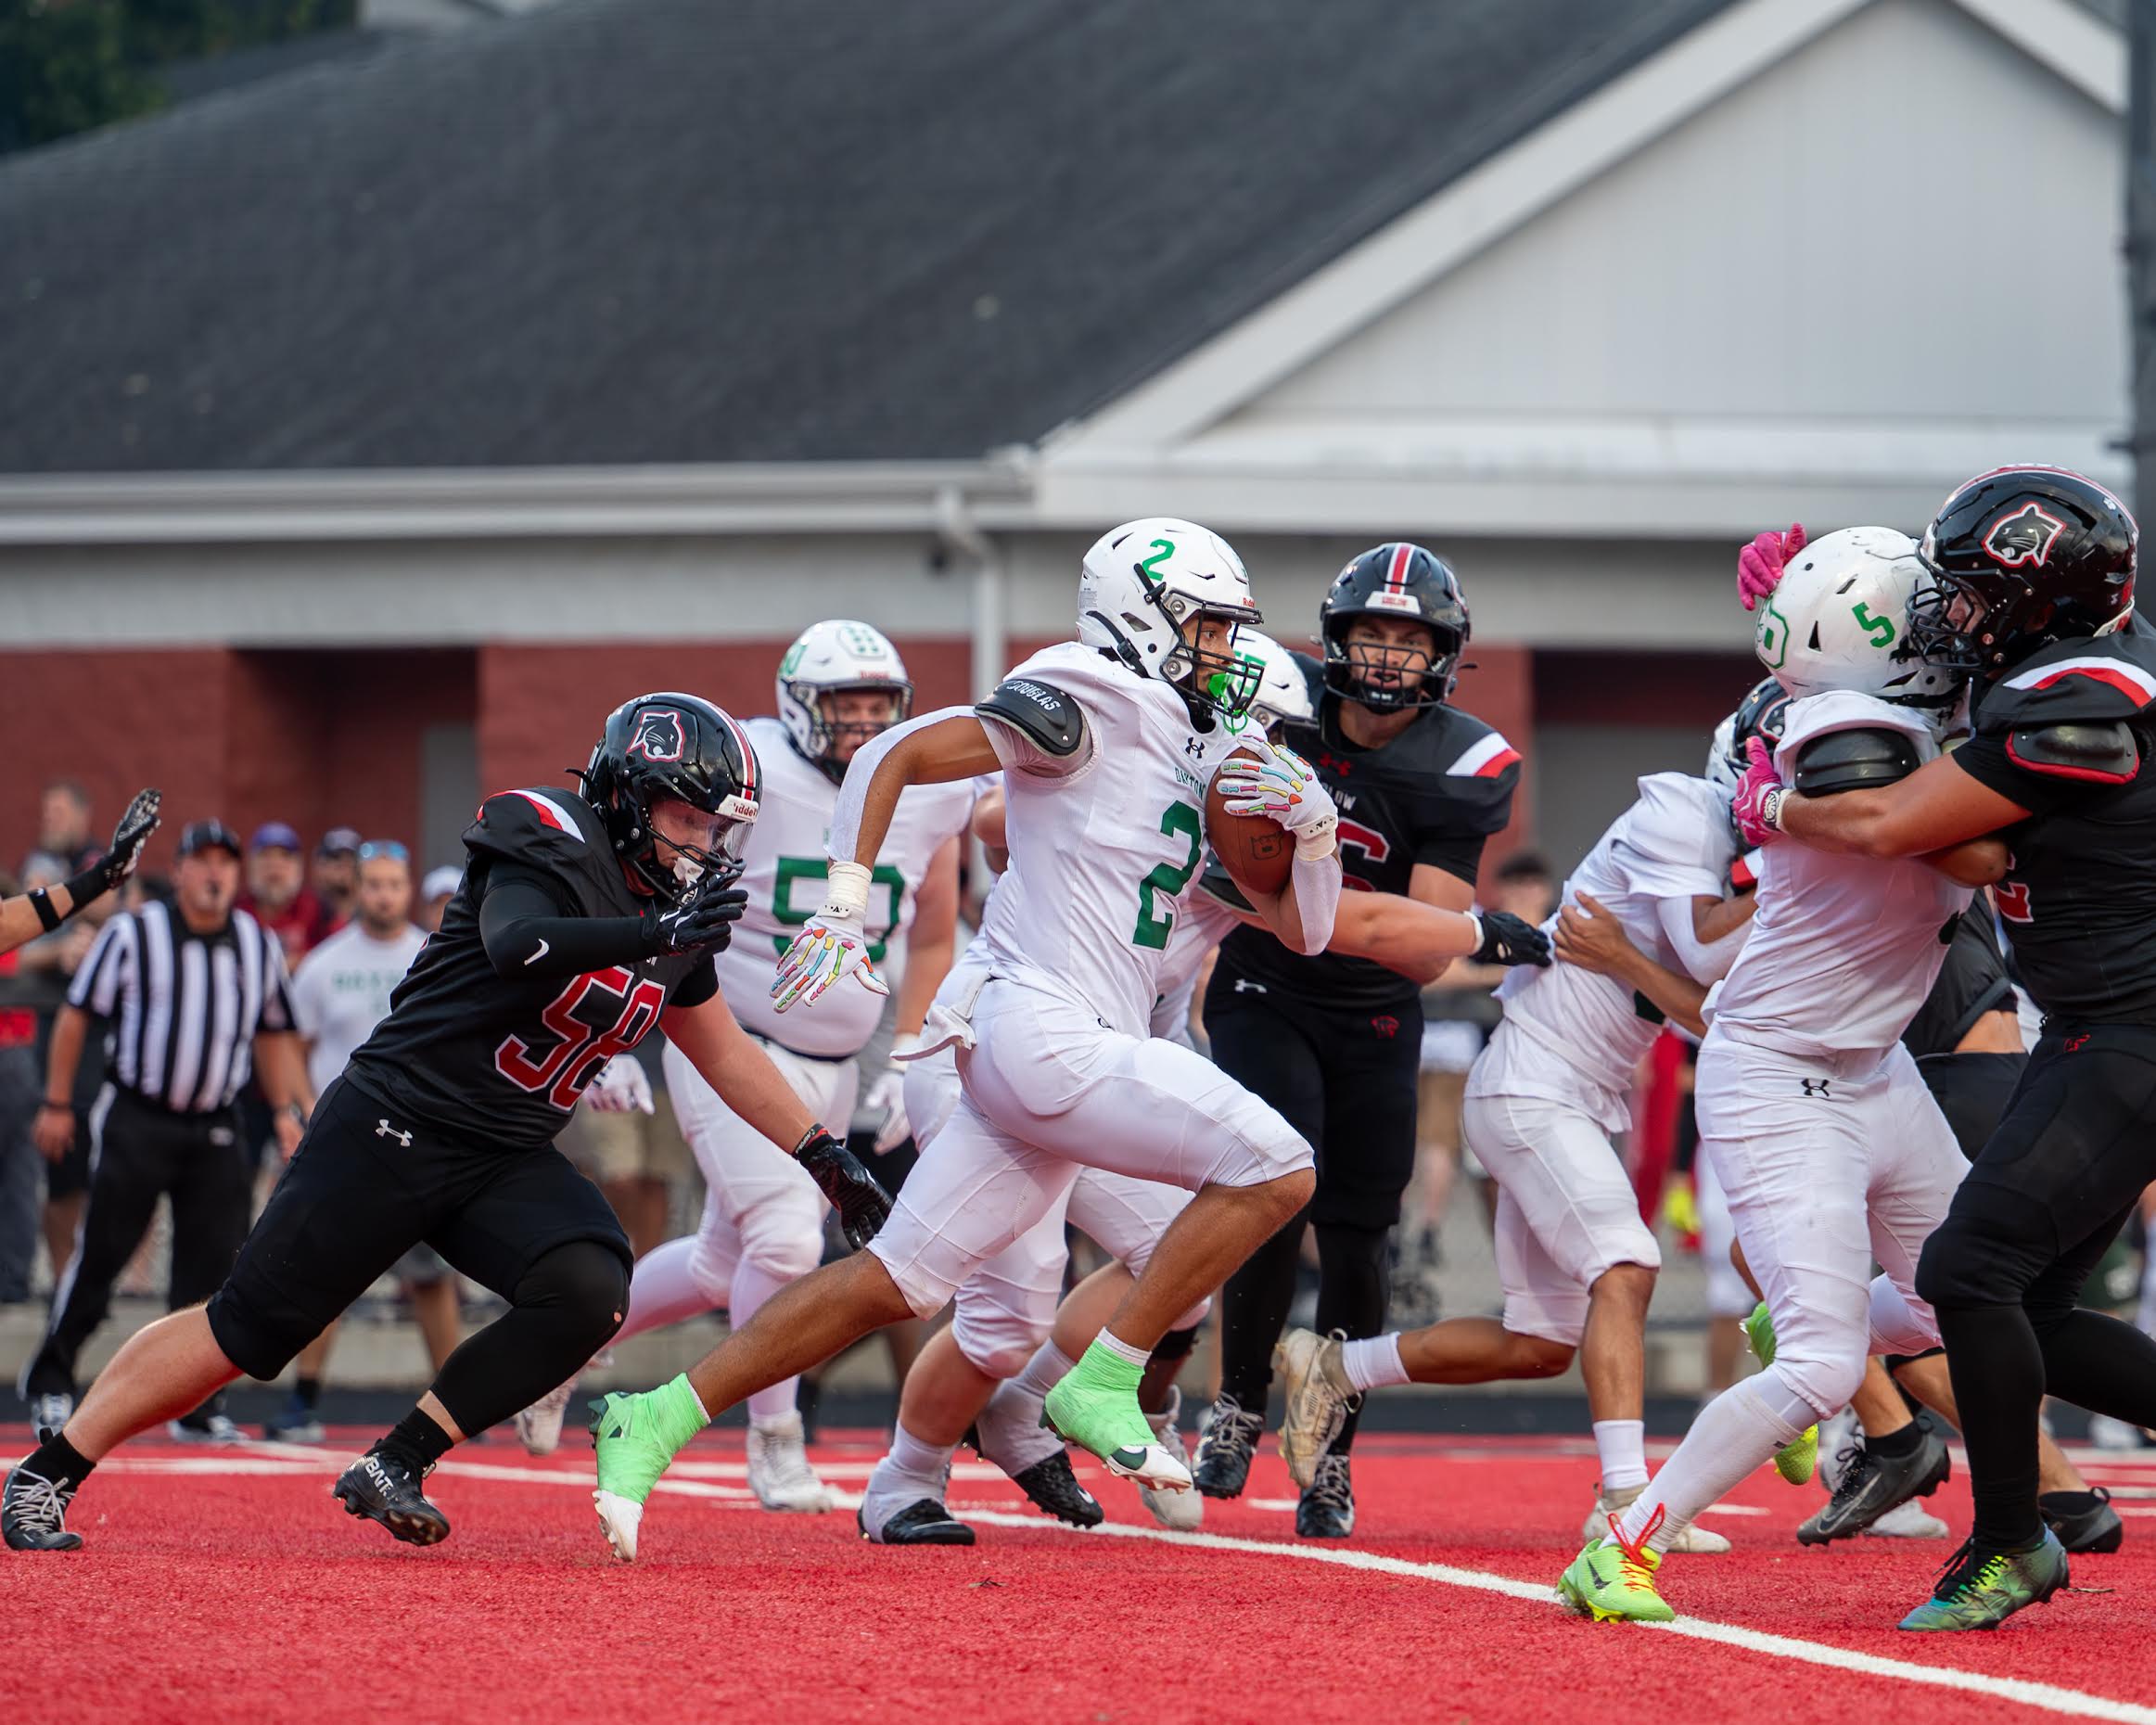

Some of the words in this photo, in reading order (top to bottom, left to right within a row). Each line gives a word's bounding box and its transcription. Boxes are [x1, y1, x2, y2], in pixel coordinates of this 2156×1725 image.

[1142, 539, 1176, 581] 2
[1852, 601, 1896, 647] 5
[1131, 799, 1203, 951] 2
[494, 965, 667, 1111] 58
